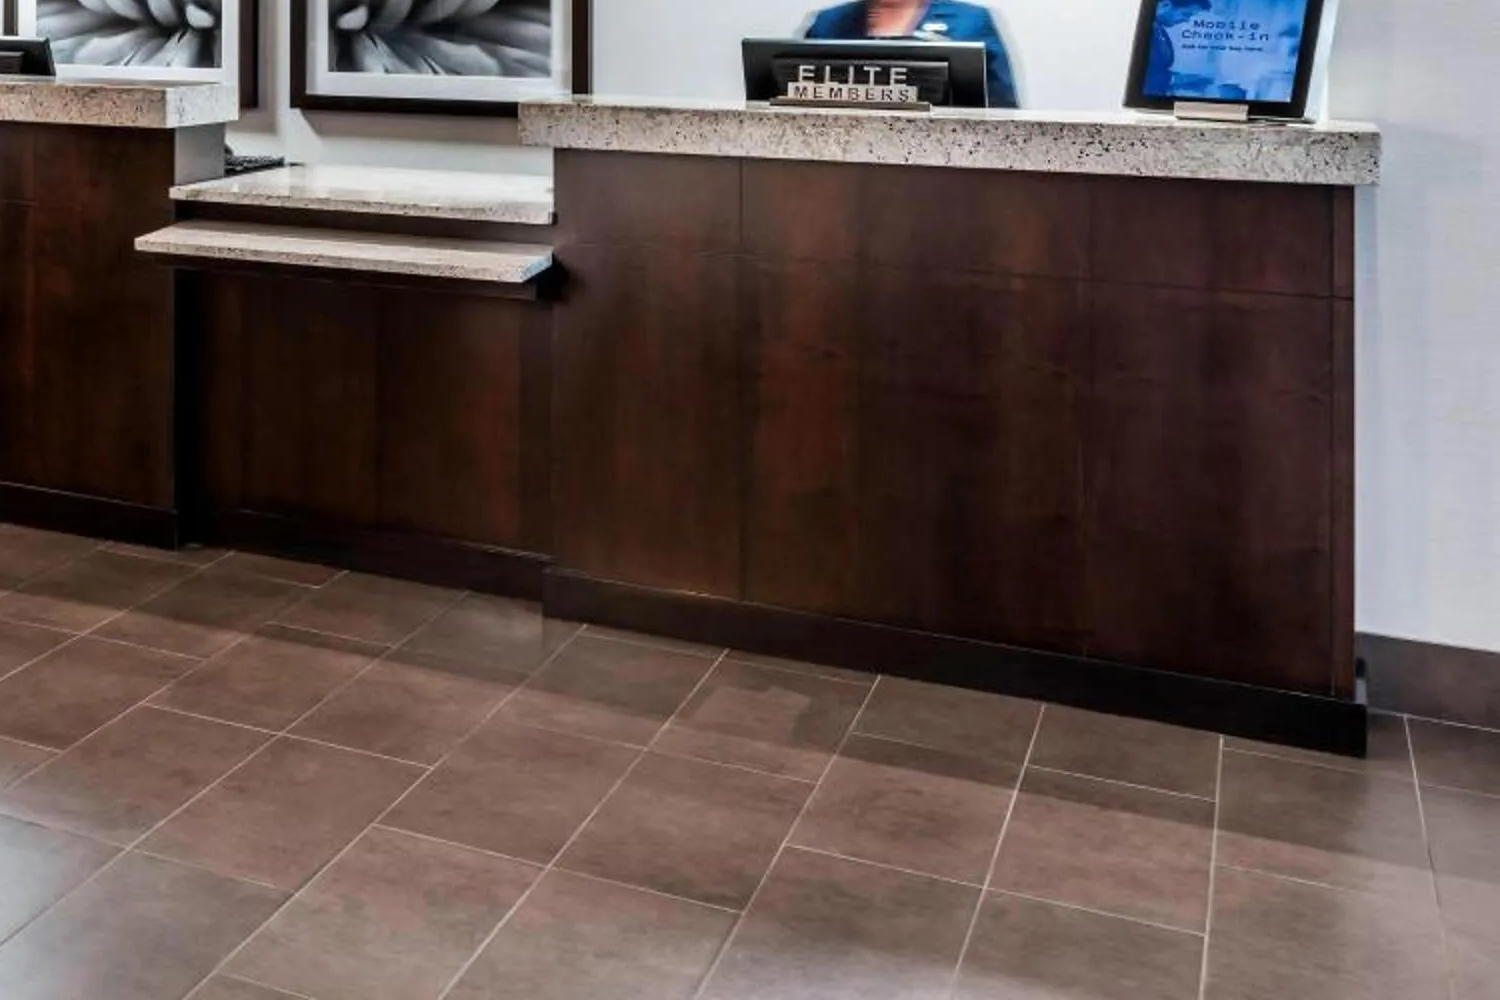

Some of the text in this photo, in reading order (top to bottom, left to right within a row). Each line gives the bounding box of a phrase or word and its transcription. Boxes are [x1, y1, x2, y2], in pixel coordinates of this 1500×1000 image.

[1194, 20, 1260, 30] Mobile
[799, 64, 908, 87] ELITE
[793, 85, 910, 102] MEMBERS
